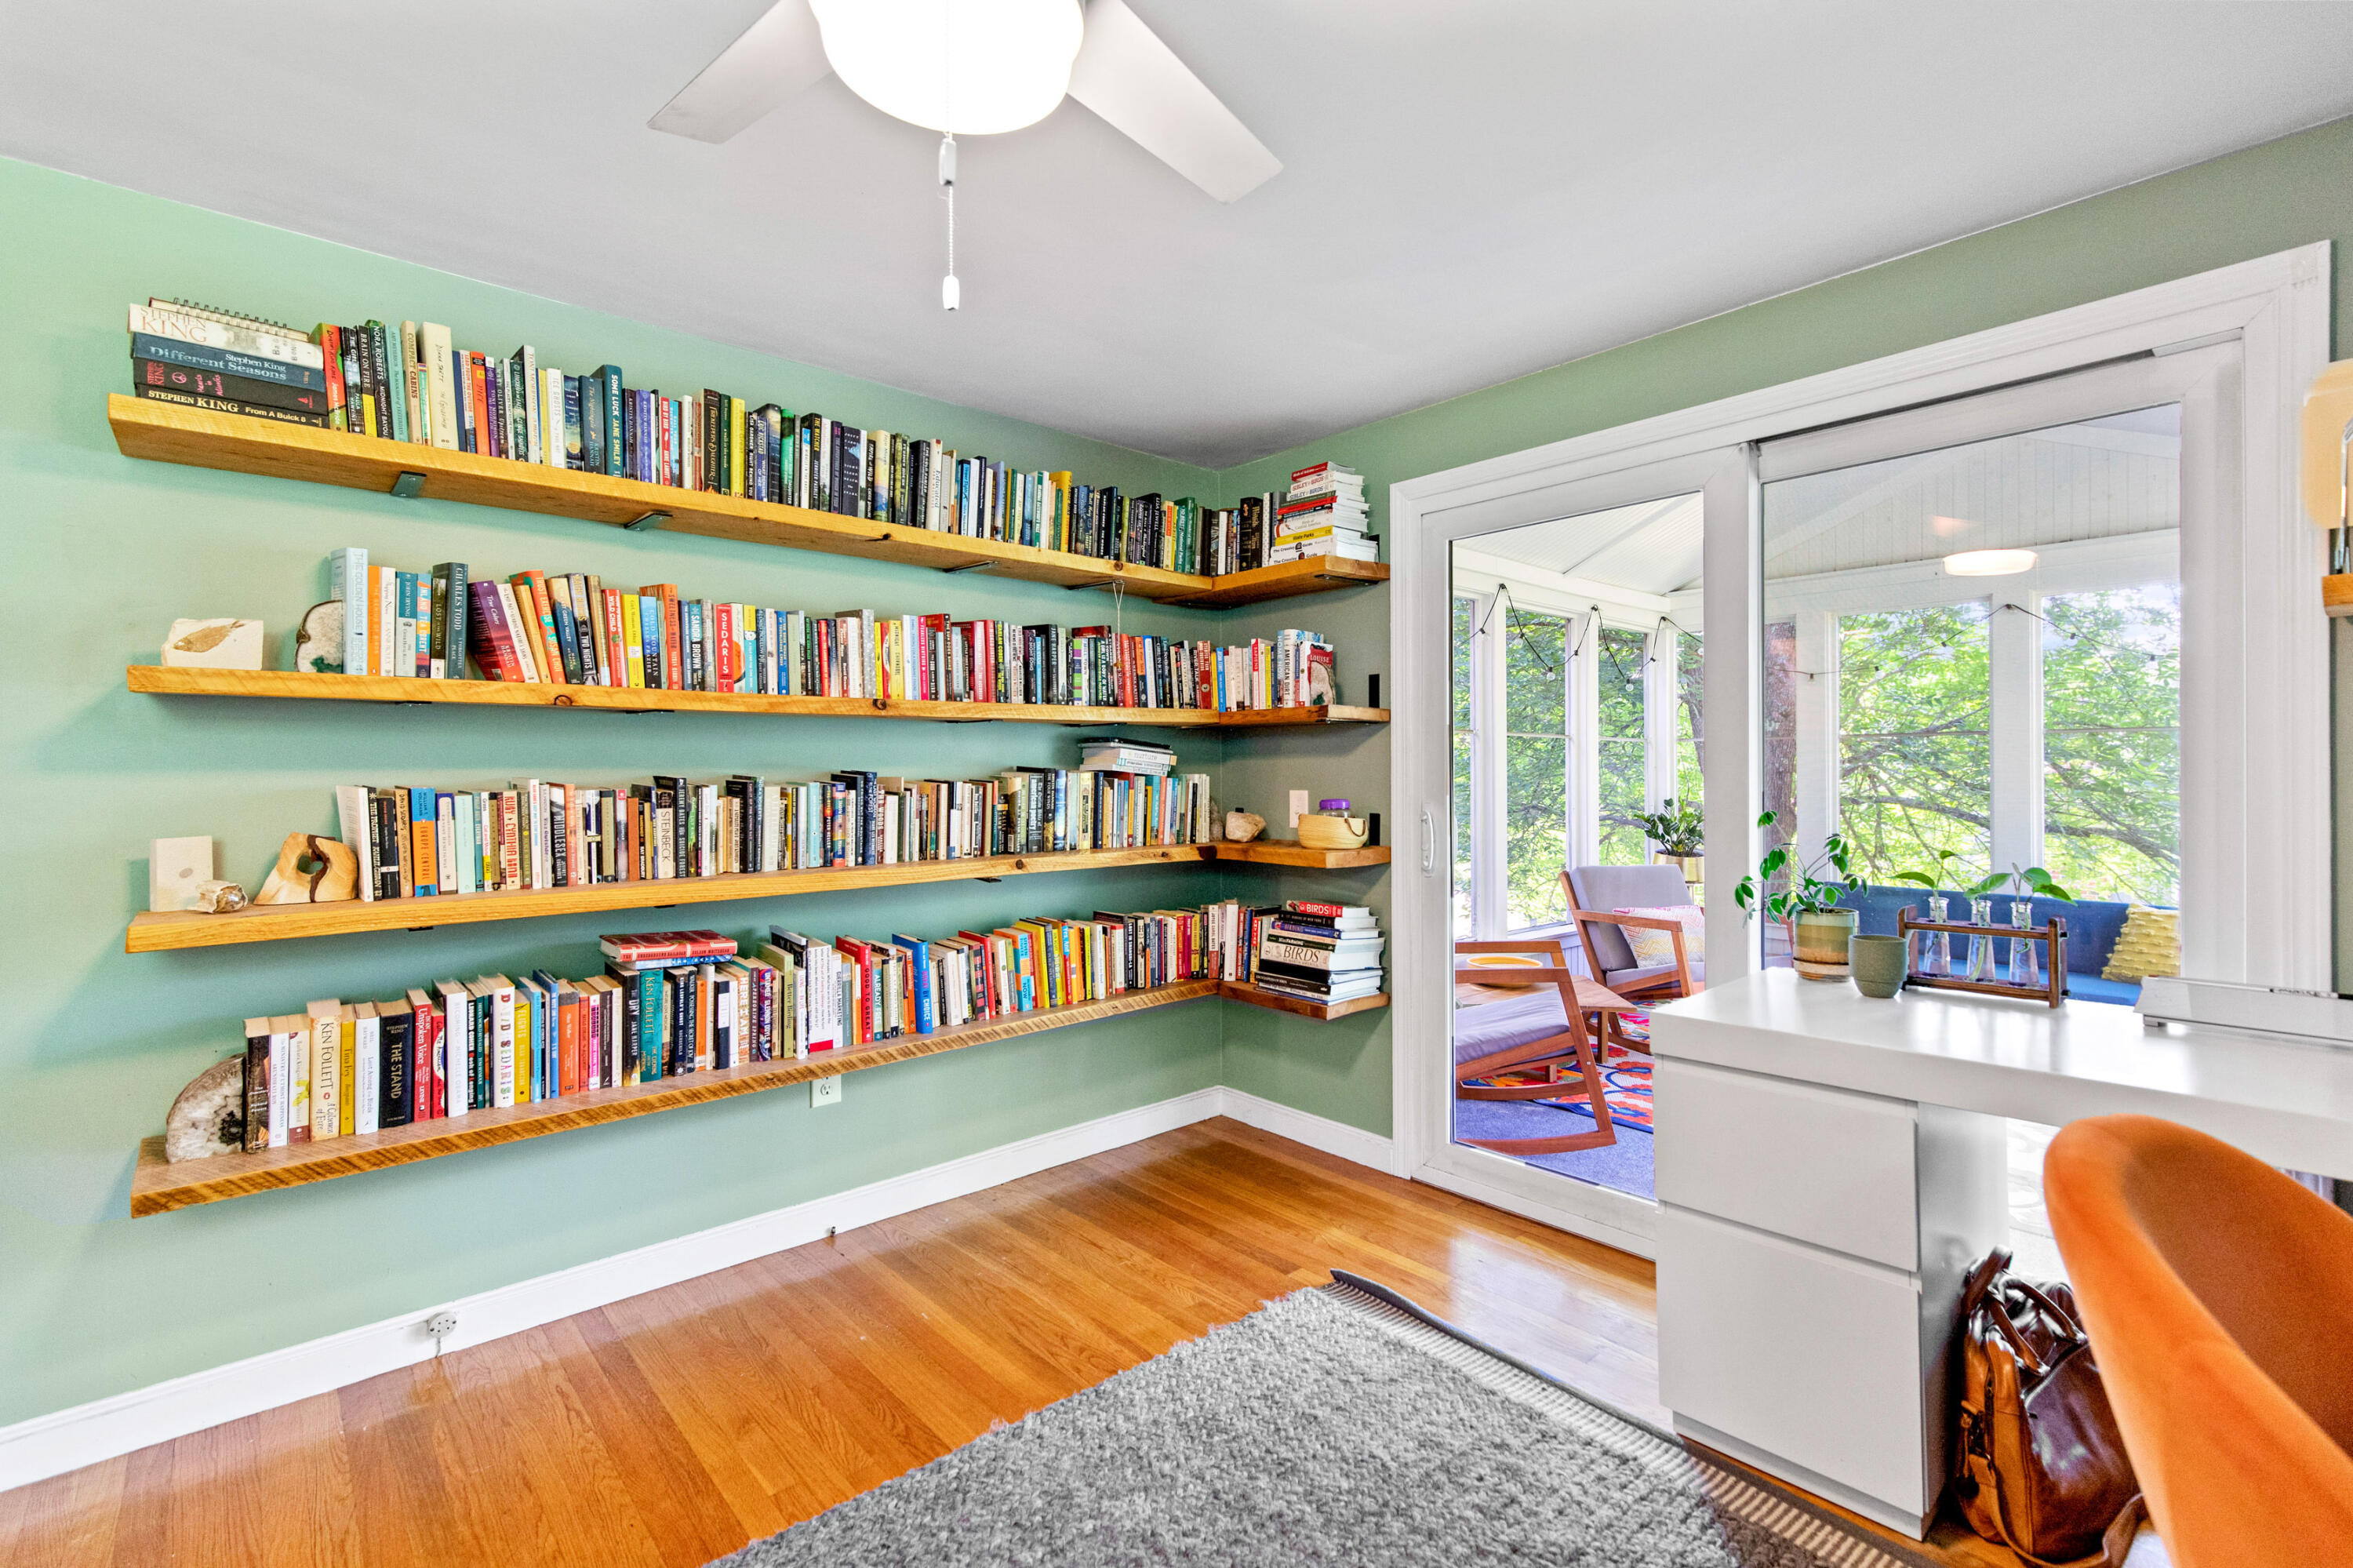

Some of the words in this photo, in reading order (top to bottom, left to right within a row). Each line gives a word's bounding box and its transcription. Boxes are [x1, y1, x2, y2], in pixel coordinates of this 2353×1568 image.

[142, 315, 208, 343] KING
[373, 326, 382, 346] NORA
[360, 333, 369, 357] BRAIN
[407, 333, 416, 369] COMPACT
[150, 346, 225, 369] Different
[227, 363, 288, 380] Seasons
[226, 353, 261, 367] Stephen
[264, 360, 287, 373] King
[362, 358, 369, 369] ON
[375, 347, 384, 380] ROBERTS
[148, 391, 195, 404] STEPHEN
[196, 398, 239, 413] KING
[245, 406, 267, 417] From
[277, 412, 300, 422] Buick
[613, 438, 621, 466] SMILEY
[1309, 486, 1323, 495] BIRDS
[1311, 476, 1324, 485] BIRDS
[454, 567, 463, 606] CHARLES
[536, 577, 546, 595] TRUST
[420, 587, 428, 609] INLAND
[454, 608, 463, 630] TODD
[490, 608, 500, 625] Colors
[691, 615, 701, 642] SANDRA
[552, 657, 562, 672] CHOI
[583, 648, 592, 669] NIGHTS
[693, 643, 702, 669] BROWN
[420, 827, 429, 849] EUROPE
[506, 823, 517, 856] CYNTHIA
[554, 815, 566, 857] MIDDLESEX
[661, 811, 671, 863] STEINBECK
[421, 853, 430, 879] CENTRAL
[1306, 904, 1329, 915] BIRDS
[1283, 945, 1321, 963] BIRDS
[645, 977, 655, 995] KEN
[739, 977, 749, 1006] HERE
[864, 992, 871, 1002] TO
[629, 999, 639, 1016] DRY
[644, 997, 655, 1034] FOLLETT
[320, 1021, 335, 1045] KEN
[415, 1008, 428, 1044] Unspoken
[518, 1010, 527, 1038] FLIGHTS
[740, 1018, 749, 1035] AM
[344, 1047, 352, 1064] Tina
[391, 1042, 402, 1062] THE
[417, 1045, 427, 1064] Voice
[320, 1046, 334, 1090] FOLLETT
[343, 1064, 352, 1077] Fey
[500, 1040, 513, 1094] SEDARIS
[365, 1070, 374, 1090] Among
[391, 1062, 402, 1100] STAND
[326, 1107, 336, 1134] Column
